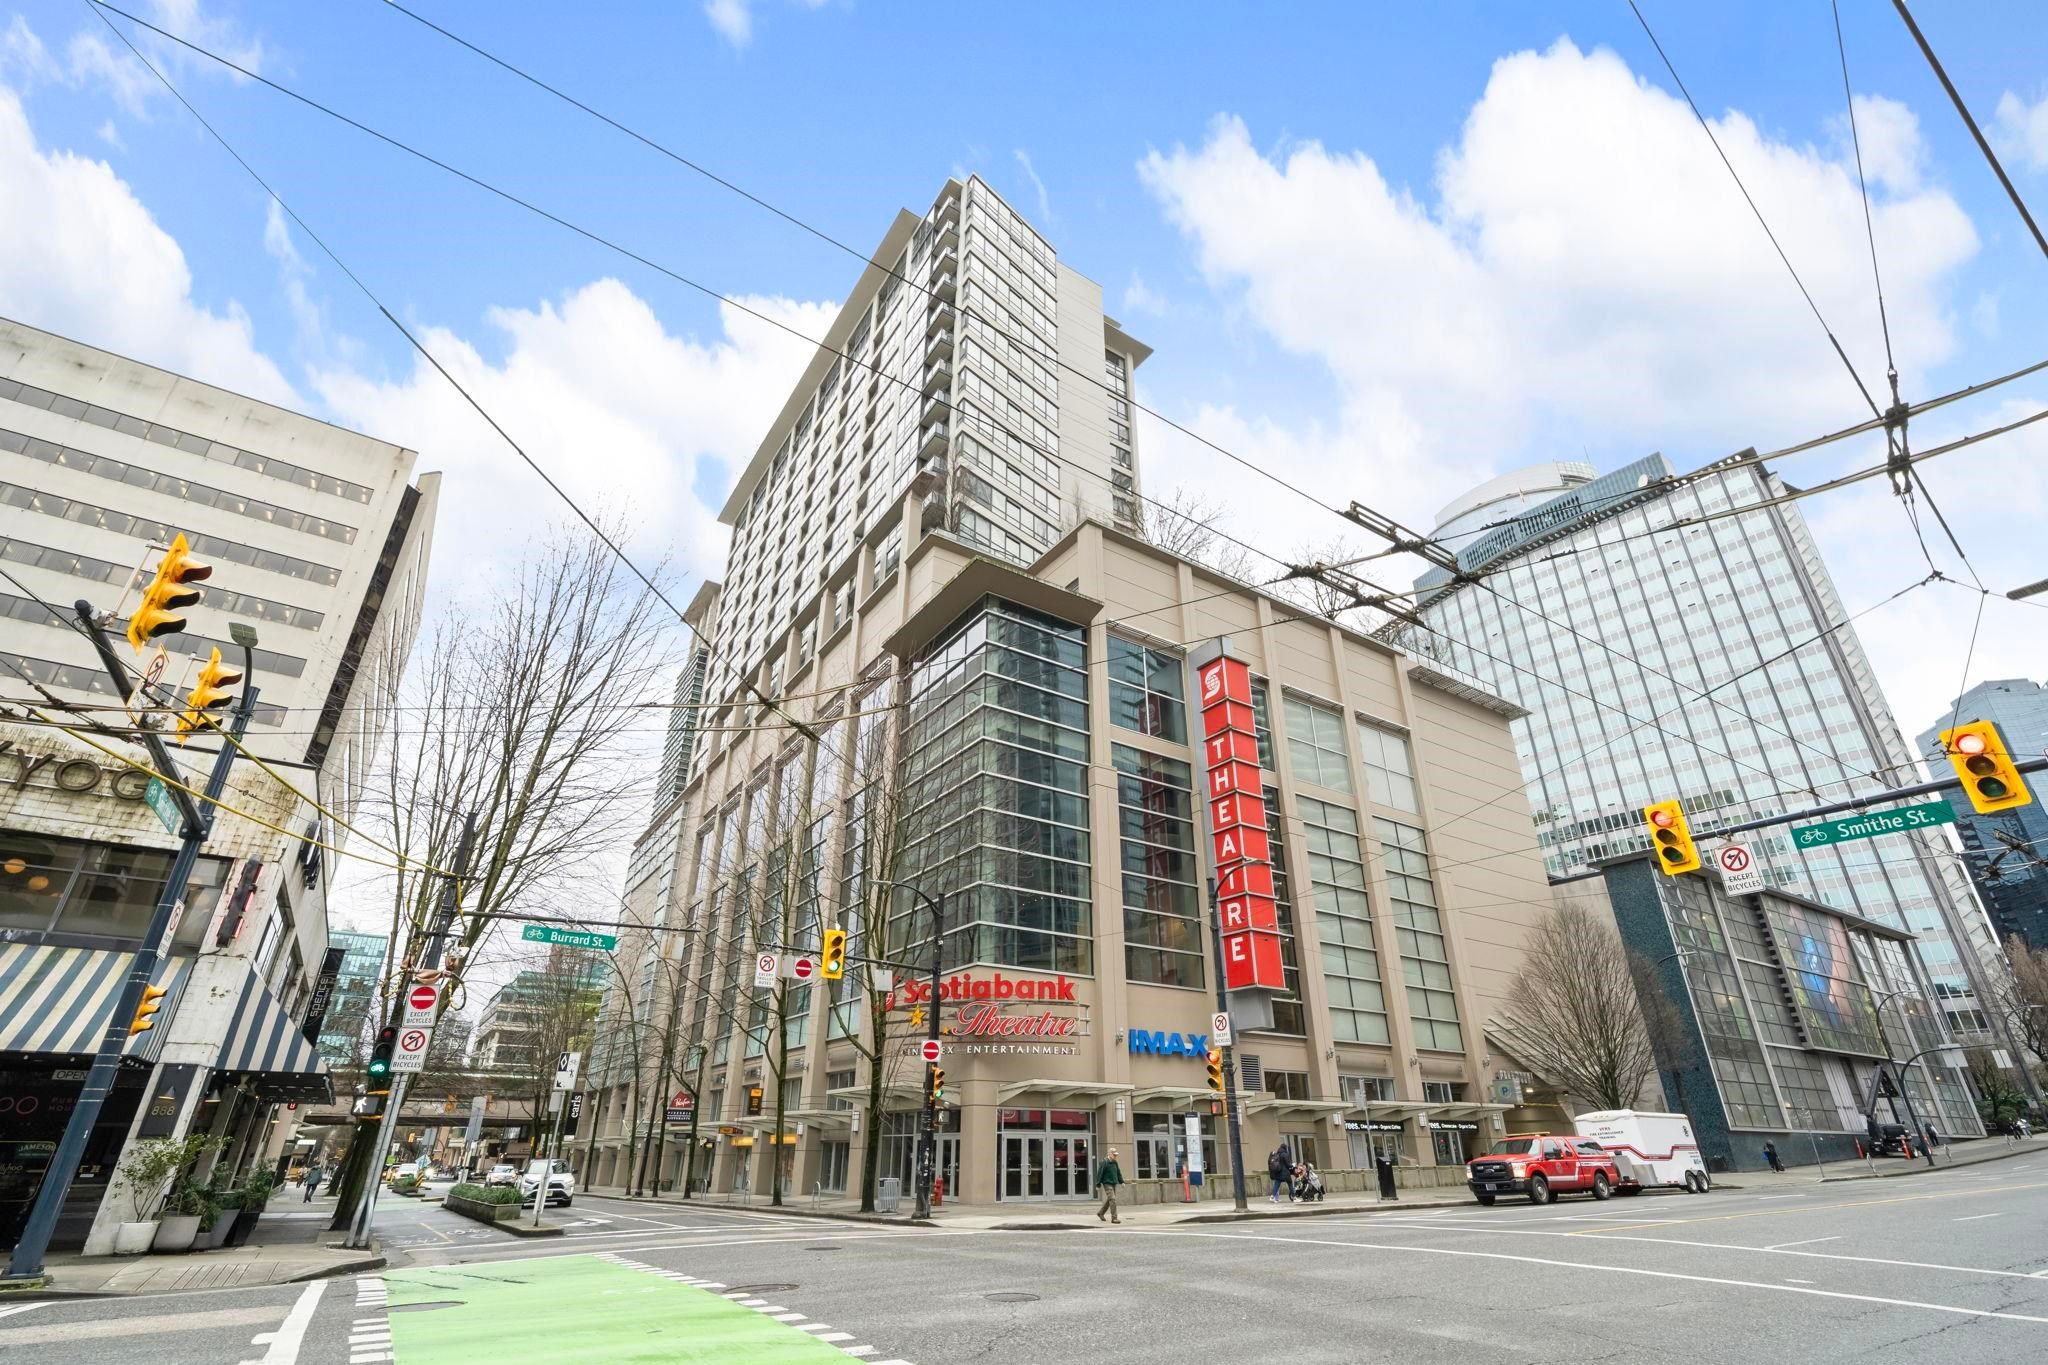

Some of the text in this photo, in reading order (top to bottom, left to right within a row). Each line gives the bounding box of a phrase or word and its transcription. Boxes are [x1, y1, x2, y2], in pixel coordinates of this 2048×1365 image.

[1837, 809, 1936, 838] Smithe St.
[1212, 737, 1246, 962] THEATRE
[1727, 880, 1761, 892] BICYCLES
[1728, 871, 1754, 882] EXCEPT
[551, 931, 606, 947] Burrard St.
[903, 973, 1076, 1004] Scotiabank
[951, 1000, 1077, 1037] Theatre
[966, 1045, 1076, 1056] ENTERTAINMENT
[1129, 1028, 1208, 1057] IMAX
[571, 1095, 582, 1118] earls
